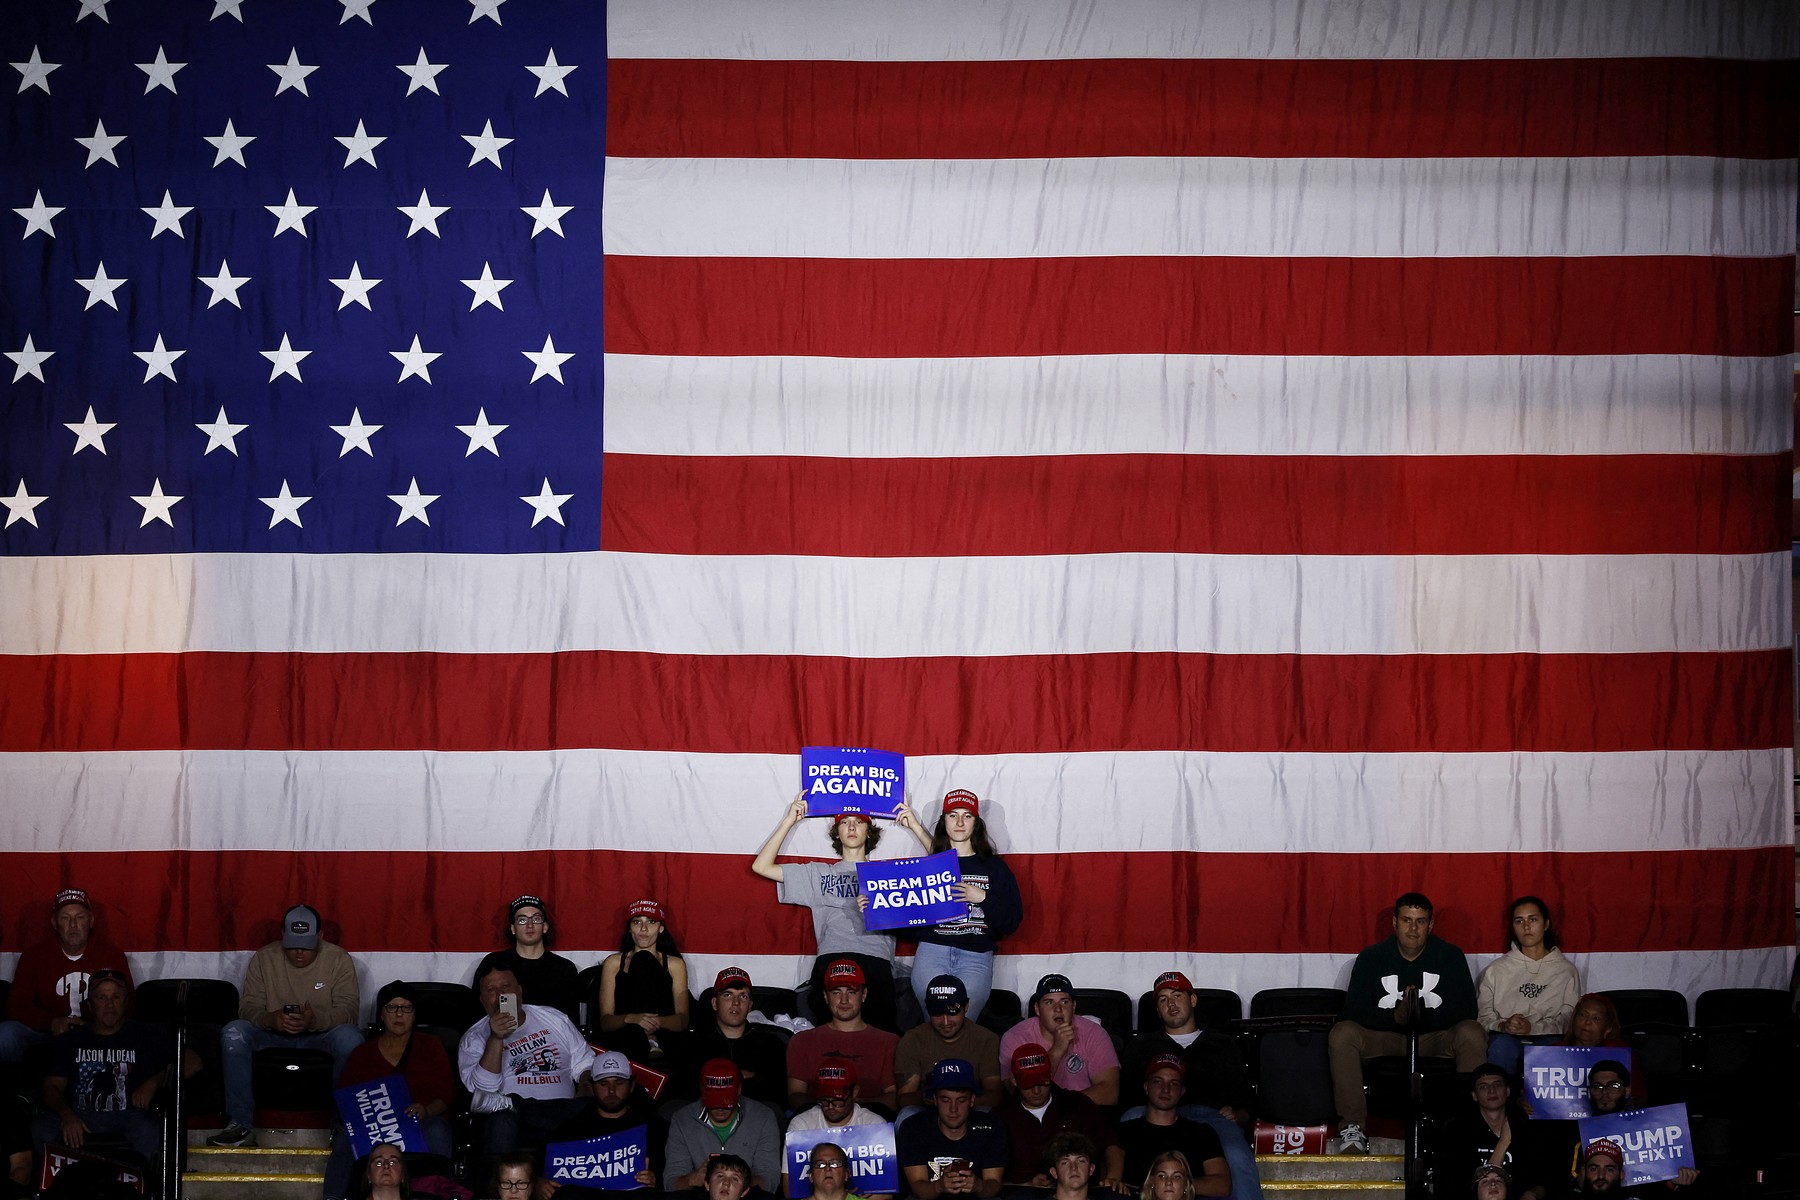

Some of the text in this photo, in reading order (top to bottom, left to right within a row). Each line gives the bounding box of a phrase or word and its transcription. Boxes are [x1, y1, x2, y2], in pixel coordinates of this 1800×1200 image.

[808, 765, 900, 782] DREAM BIG,
[810, 778, 892, 797] AGAIN!
[866, 877, 922, 892] DREAM
[926, 870, 957, 886] BIG,
[836, 884, 860, 898] NAV
[872, 885, 953, 910] AGAIN!
[829, 966, 857, 976] TRUMP
[930, 986, 957, 995] TRUMP
[508, 1036, 529, 1049] VOTING
[527, 1032, 540, 1041] FOR
[539, 1029, 551, 1037] THE
[509, 1036, 547, 1057] OUTLAW
[75, 1048, 136, 1063] JASON ALDEAN
[818, 1069, 846, 1078] TRUMP
[941, 1065, 960, 1074] USA
[1532, 1067, 1592, 1087] TRU
[517, 1075, 562, 1085] HILLBILLY
[1532, 1087, 1574, 1099] WILL
[355, 1089, 383, 1145] WILL FIX
[346, 1122, 355, 1137] 2024
[553, 1144, 641, 1166] DREAM BIG,
[857, 1144, 890, 1158] BIG,
[1638, 1147, 1666, 1163] FIX
[1668, 1145, 1684, 1159] IT
[552, 1157, 635, 1179] AGAIN!
[798, 1159, 884, 1181] AIN!
[1633, 1175, 1652, 1183] 2024
